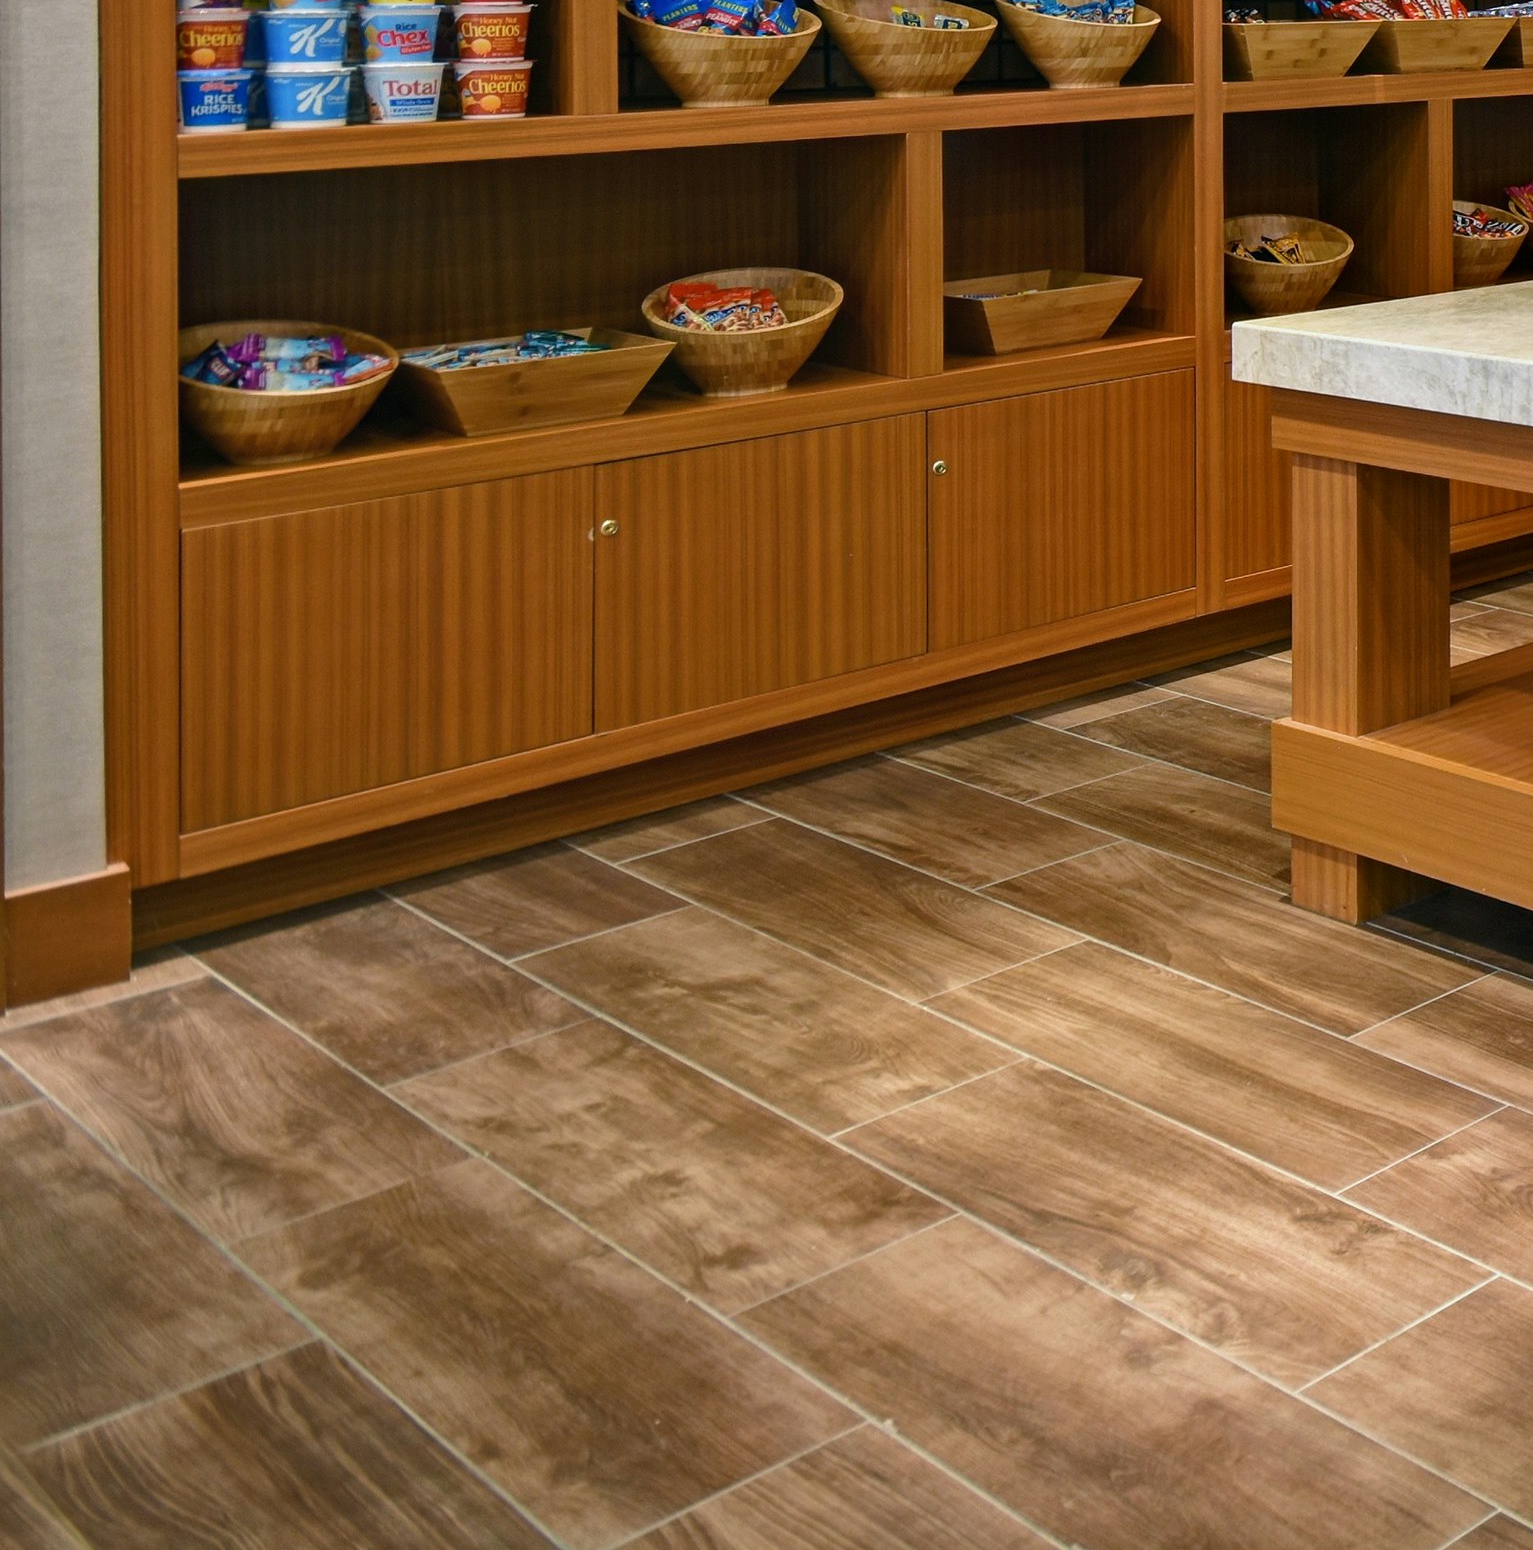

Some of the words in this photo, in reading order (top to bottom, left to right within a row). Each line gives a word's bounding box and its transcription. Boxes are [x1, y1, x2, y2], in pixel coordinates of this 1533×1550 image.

[663, 4, 698, 22] PLANTERS
[713, 0, 749, 14] PLANTERS
[480, 17, 503, 25] Honey
[289, 18, 336, 58] K
[461, 23, 520, 38] Cheerios
[377, 30, 429, 47] Chex
[490, 74, 513, 82] Honey
[382, 79, 437, 97] Total
[469, 79, 527, 94] Cheerios
[204, 94, 235, 104] RICE
[296, 76, 340, 116] K
[191, 104, 242, 117] KRISPIES
